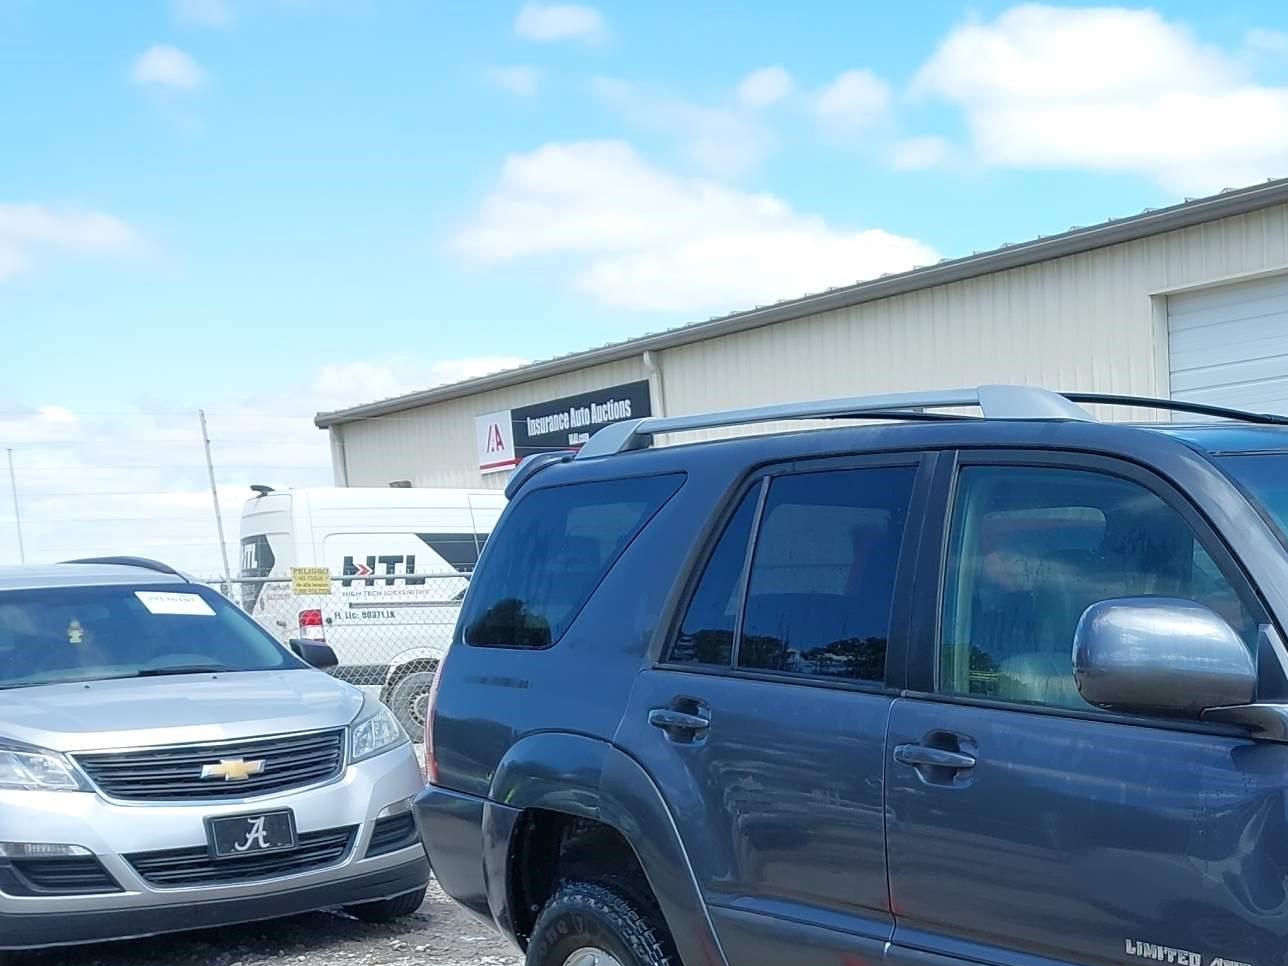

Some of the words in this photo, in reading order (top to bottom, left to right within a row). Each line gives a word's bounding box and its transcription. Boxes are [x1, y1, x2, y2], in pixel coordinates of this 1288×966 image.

[527, 411, 569, 437] Insurance
[570, 406, 590, 428] Auto
[591, 398, 632, 424] Auctions
[293, 567, 329, 575] PELIGRO
